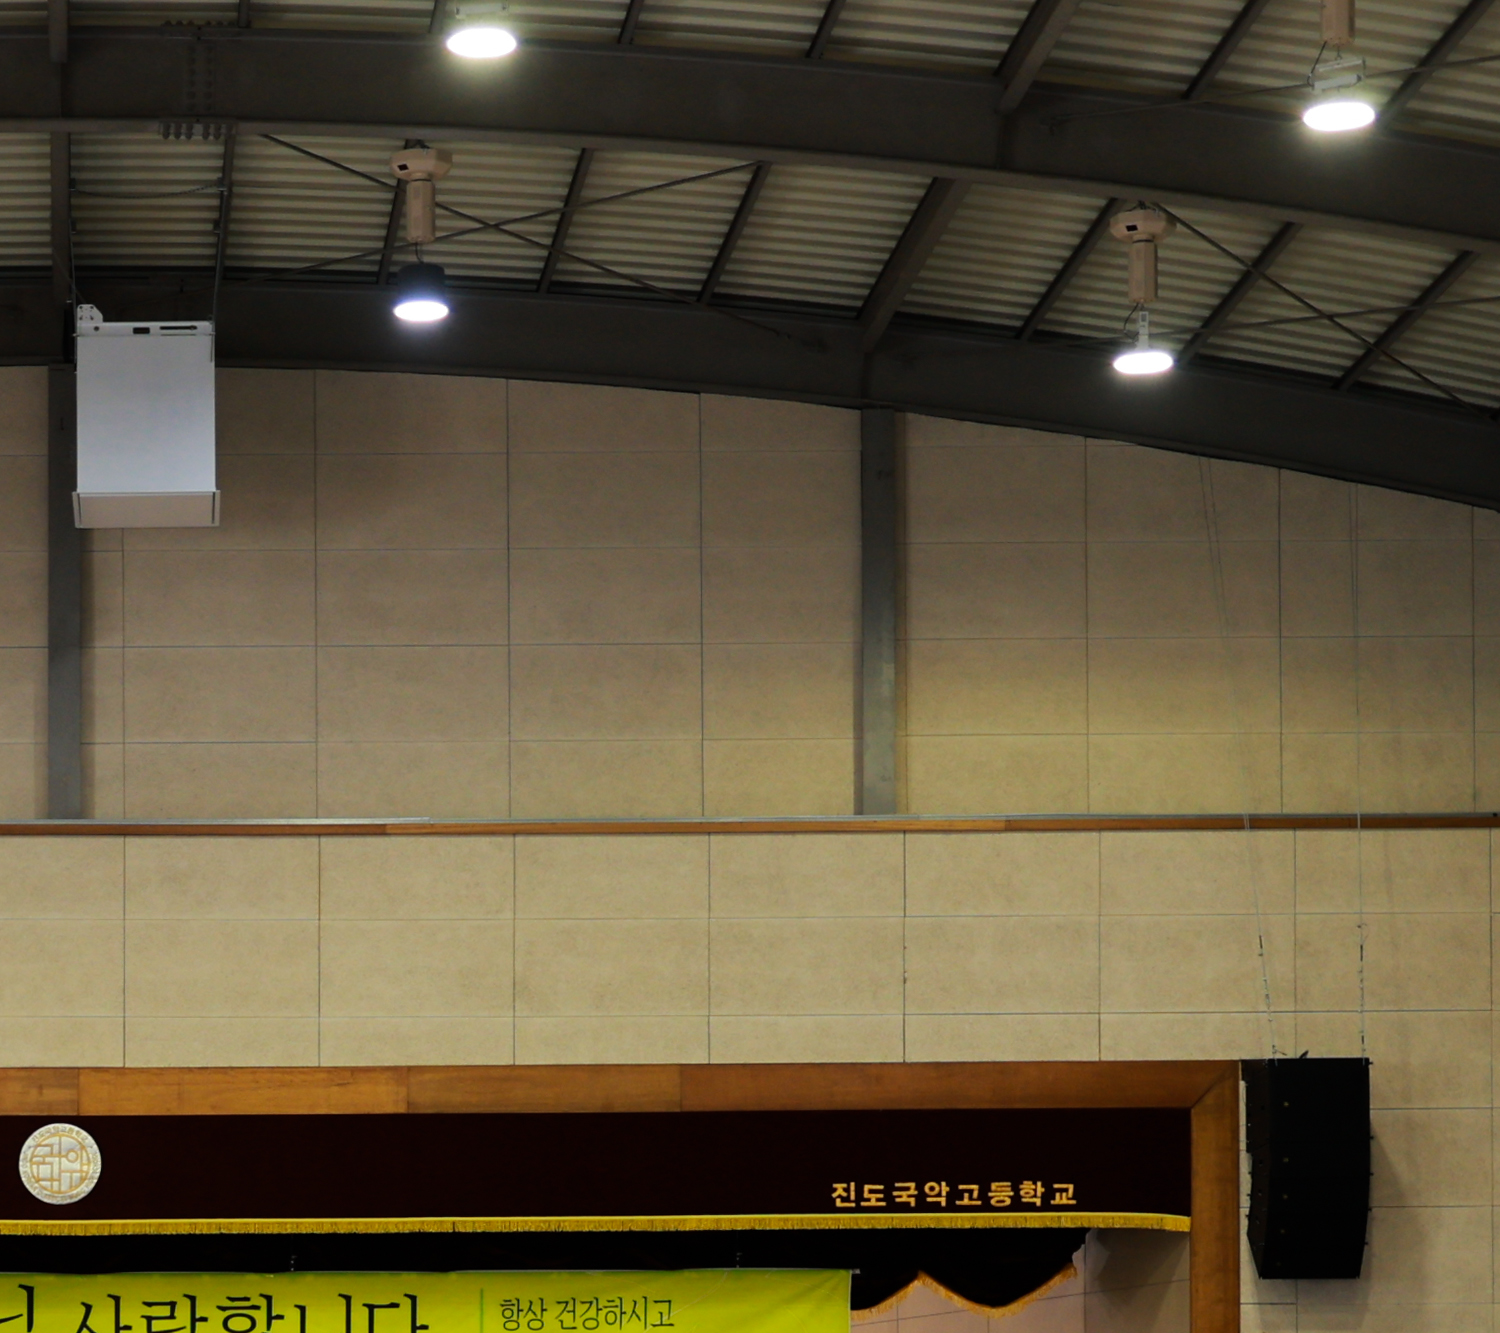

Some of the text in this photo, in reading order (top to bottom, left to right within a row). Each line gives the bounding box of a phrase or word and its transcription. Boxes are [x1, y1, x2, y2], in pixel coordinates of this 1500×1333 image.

[831, 1181, 1077, 1207] 진도국악고등학교
[499, 1297, 675, 1331] 항상 건강하시고
